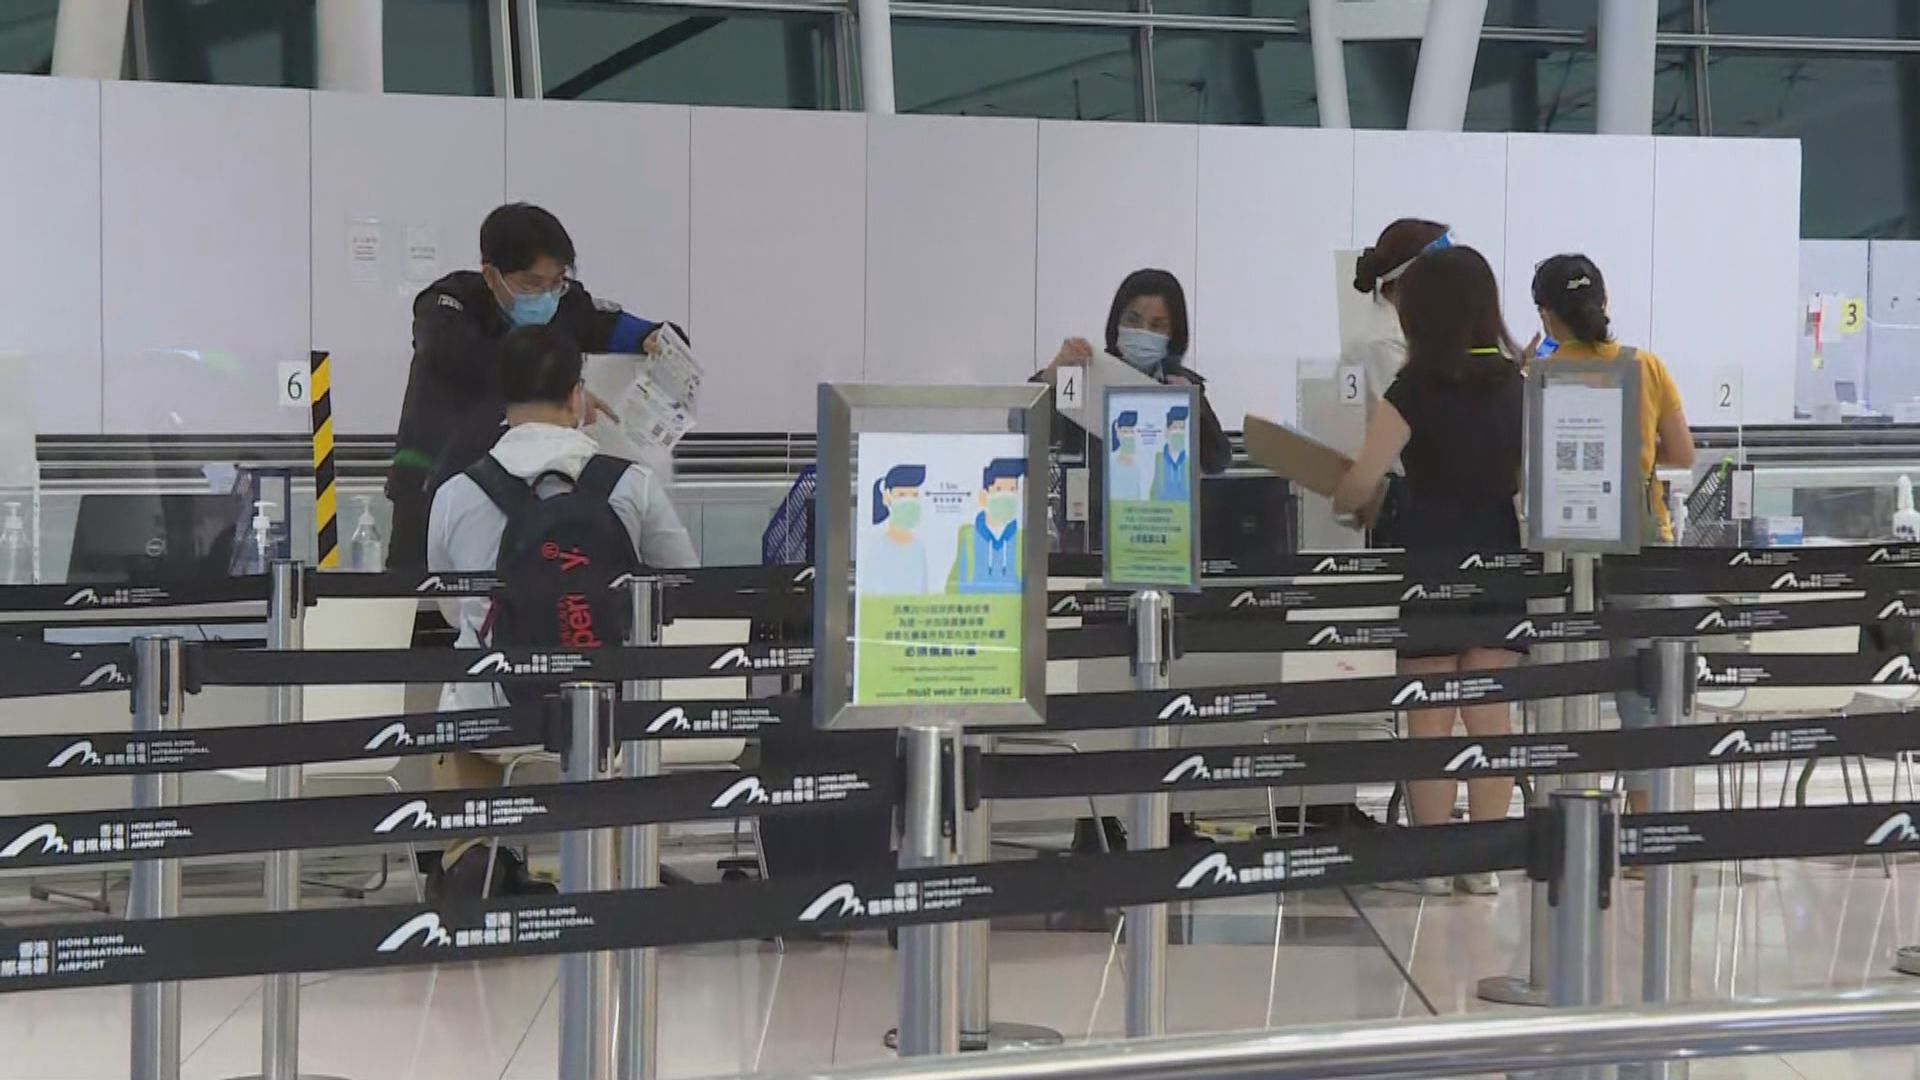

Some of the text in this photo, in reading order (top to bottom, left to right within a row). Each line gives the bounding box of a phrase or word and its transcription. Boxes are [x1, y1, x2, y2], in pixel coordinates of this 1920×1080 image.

[1846, 303, 1857, 325] 3
[287, 371, 302, 401] 6
[1063, 376, 1076, 401] 4
[1346, 373, 1357, 399] 3
[1719, 383, 1731, 407] 2
[131, 820, 177, 830] HONG KONG
[131, 828, 193, 840] INTERNATIONAL
[131, 839, 165, 849] AIRPORT
[518, 906, 577, 918] HONG KONG
[518, 917, 595, 930] INTERNATIONAL
[57, 935, 124, 948] HONG KONG
[518, 930, 560, 941] AIRPORT
[57, 945, 146, 960] INTERNATIONAL
[57, 960, 105, 972] AIRPORT
